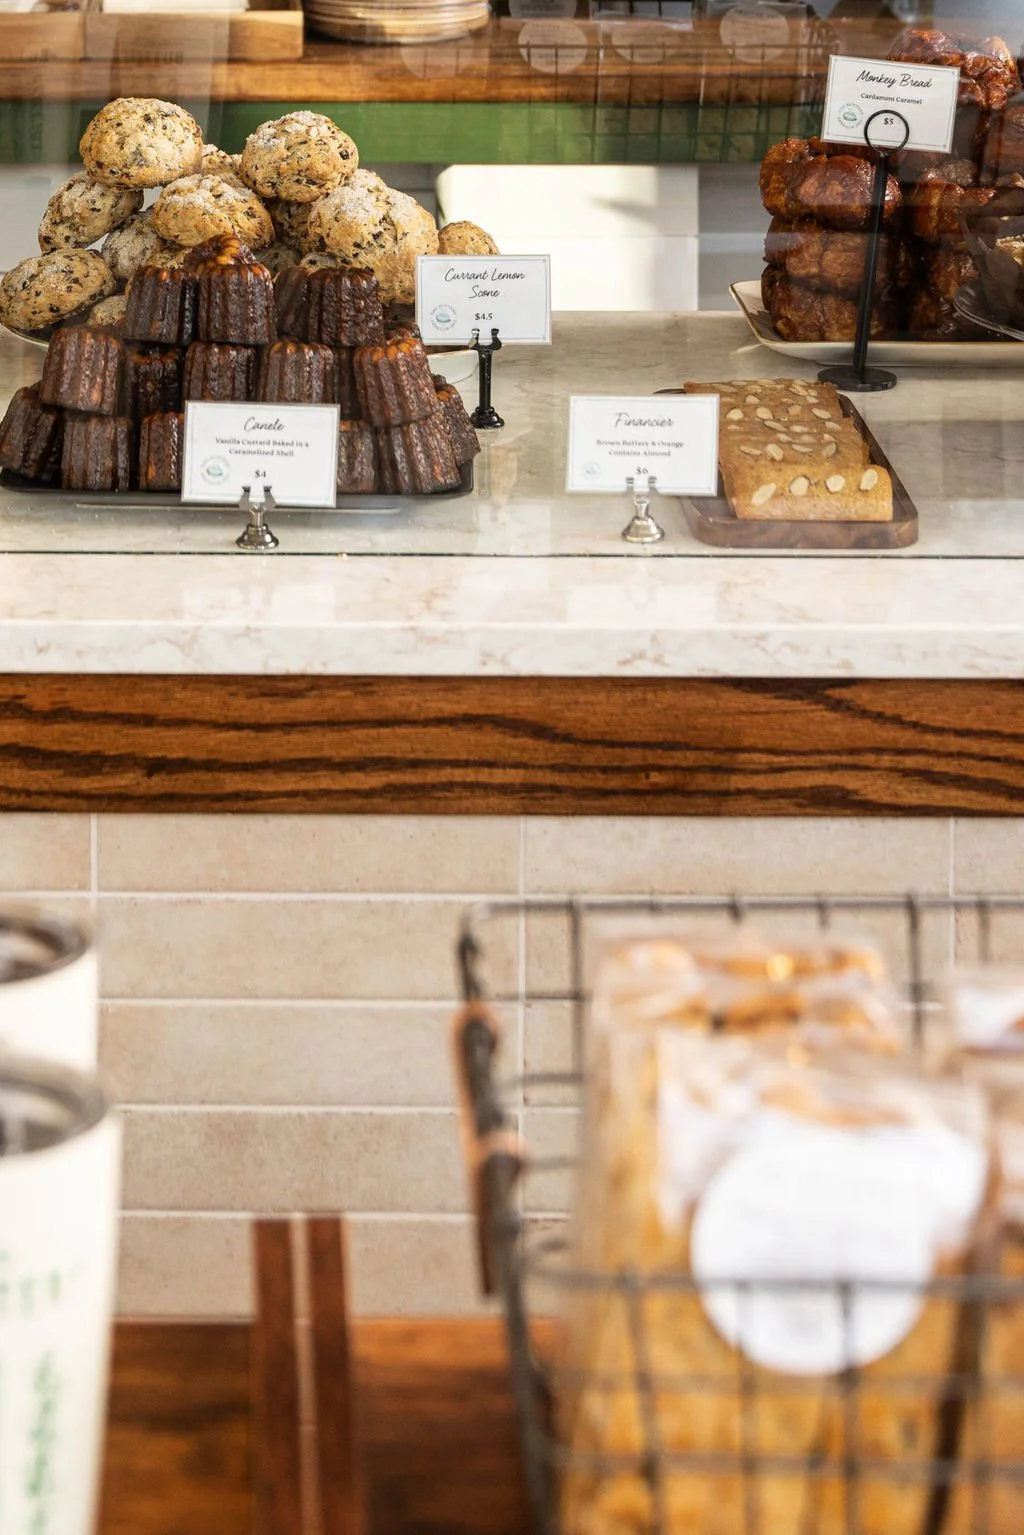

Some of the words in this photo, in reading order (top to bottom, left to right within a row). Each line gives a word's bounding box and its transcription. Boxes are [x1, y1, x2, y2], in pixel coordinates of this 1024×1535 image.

[855, 69, 898, 88] Monkey
[899, 73, 933, 89] Bread
[896, 95, 923, 105] Caramel
[883, 117, 894, 126] $5
[444, 267, 489, 282] Currant
[491, 268, 526, 281] Lemon
[468, 284, 501, 299] Scone
[474, 312, 494, 321] $4.5
[614, 412, 675, 429] Financier
[254, 469, 267, 478] $4
